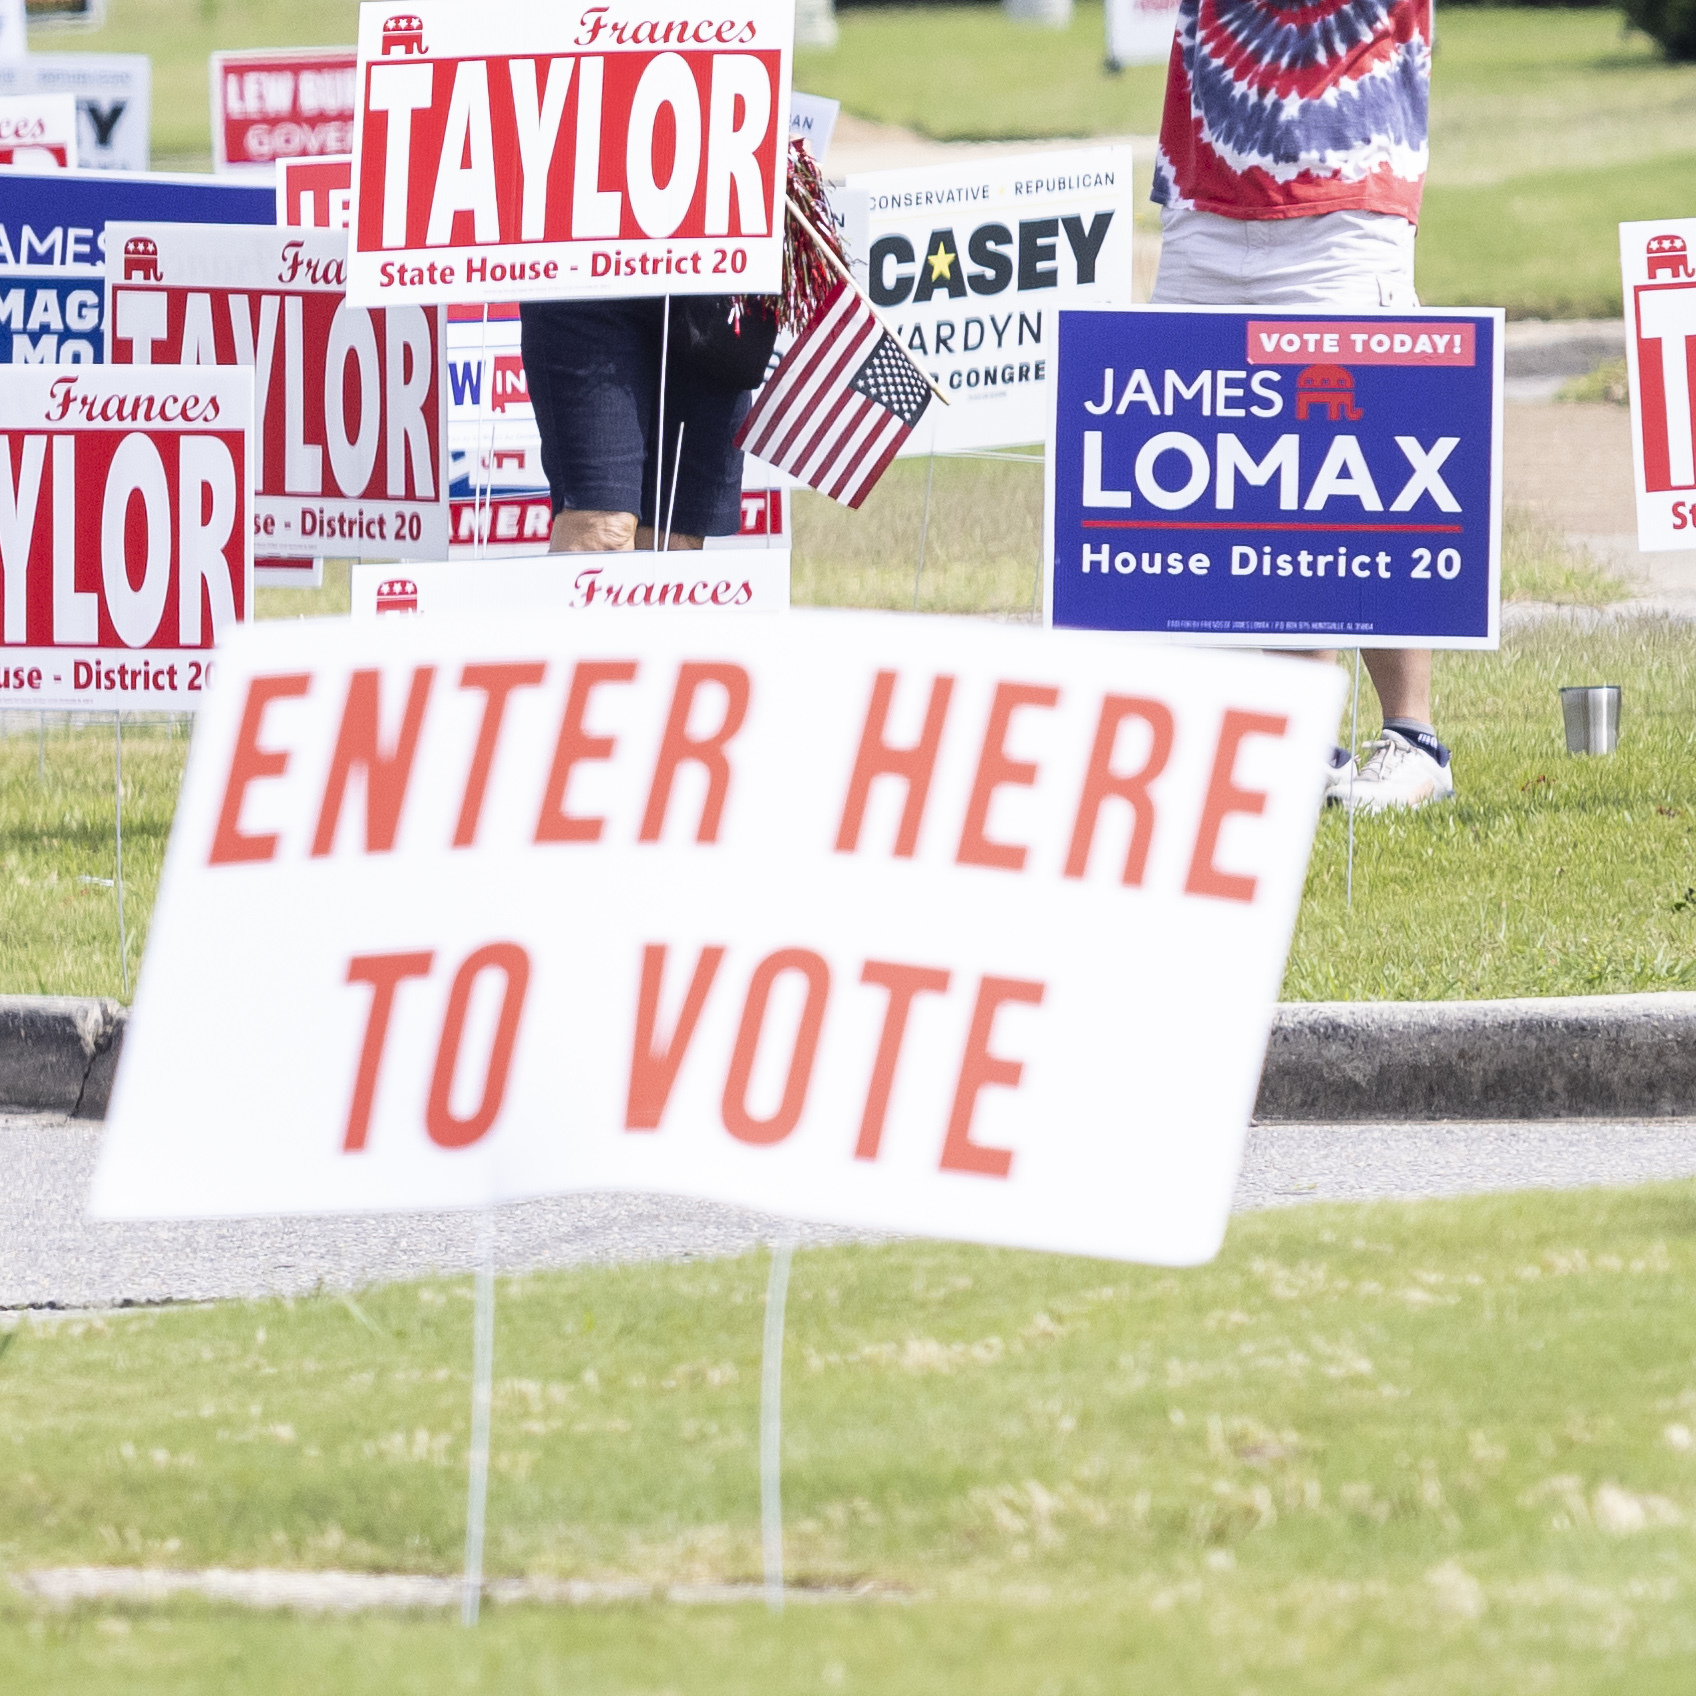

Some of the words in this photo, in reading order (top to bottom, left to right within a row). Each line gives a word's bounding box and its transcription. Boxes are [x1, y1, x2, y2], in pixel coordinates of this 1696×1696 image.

[574, 6, 757, 46] Frances
[369, 51, 772, 249] TAYLOR
[1014, 172, 1115, 196] REPUBLICAN
[379, 260, 455, 287] State
[466, 255, 559, 284] House
[591, 249, 702, 277] District
[712, 248, 748, 274] 20
[869, 209, 1116, 308] CASEY
[898, 310, 1044, 357] ARDYN
[1259, 332, 1340, 353] VOTE
[1350, 333, 1463, 355] TODAY!
[949, 360, 1046, 390] CONGRE
[1083, 368, 1284, 418] JAMES
[45, 376, 221, 424] Frances
[1082, 431, 1463, 513] LOMAX
[301, 507, 387, 541] District
[393, 511, 422, 543] 20
[1082, 543, 1211, 576] House
[1230, 544, 1392, 579] District
[1410, 548, 1462, 580] 20
[569, 567, 753, 608] Frances
[73, 659, 178, 691] District
[207, 658, 753, 867] ENTER
[832, 667, 1289, 904] HERE
[341, 940, 532, 1154] TO
[621, 942, 1047, 1180] VOTE
